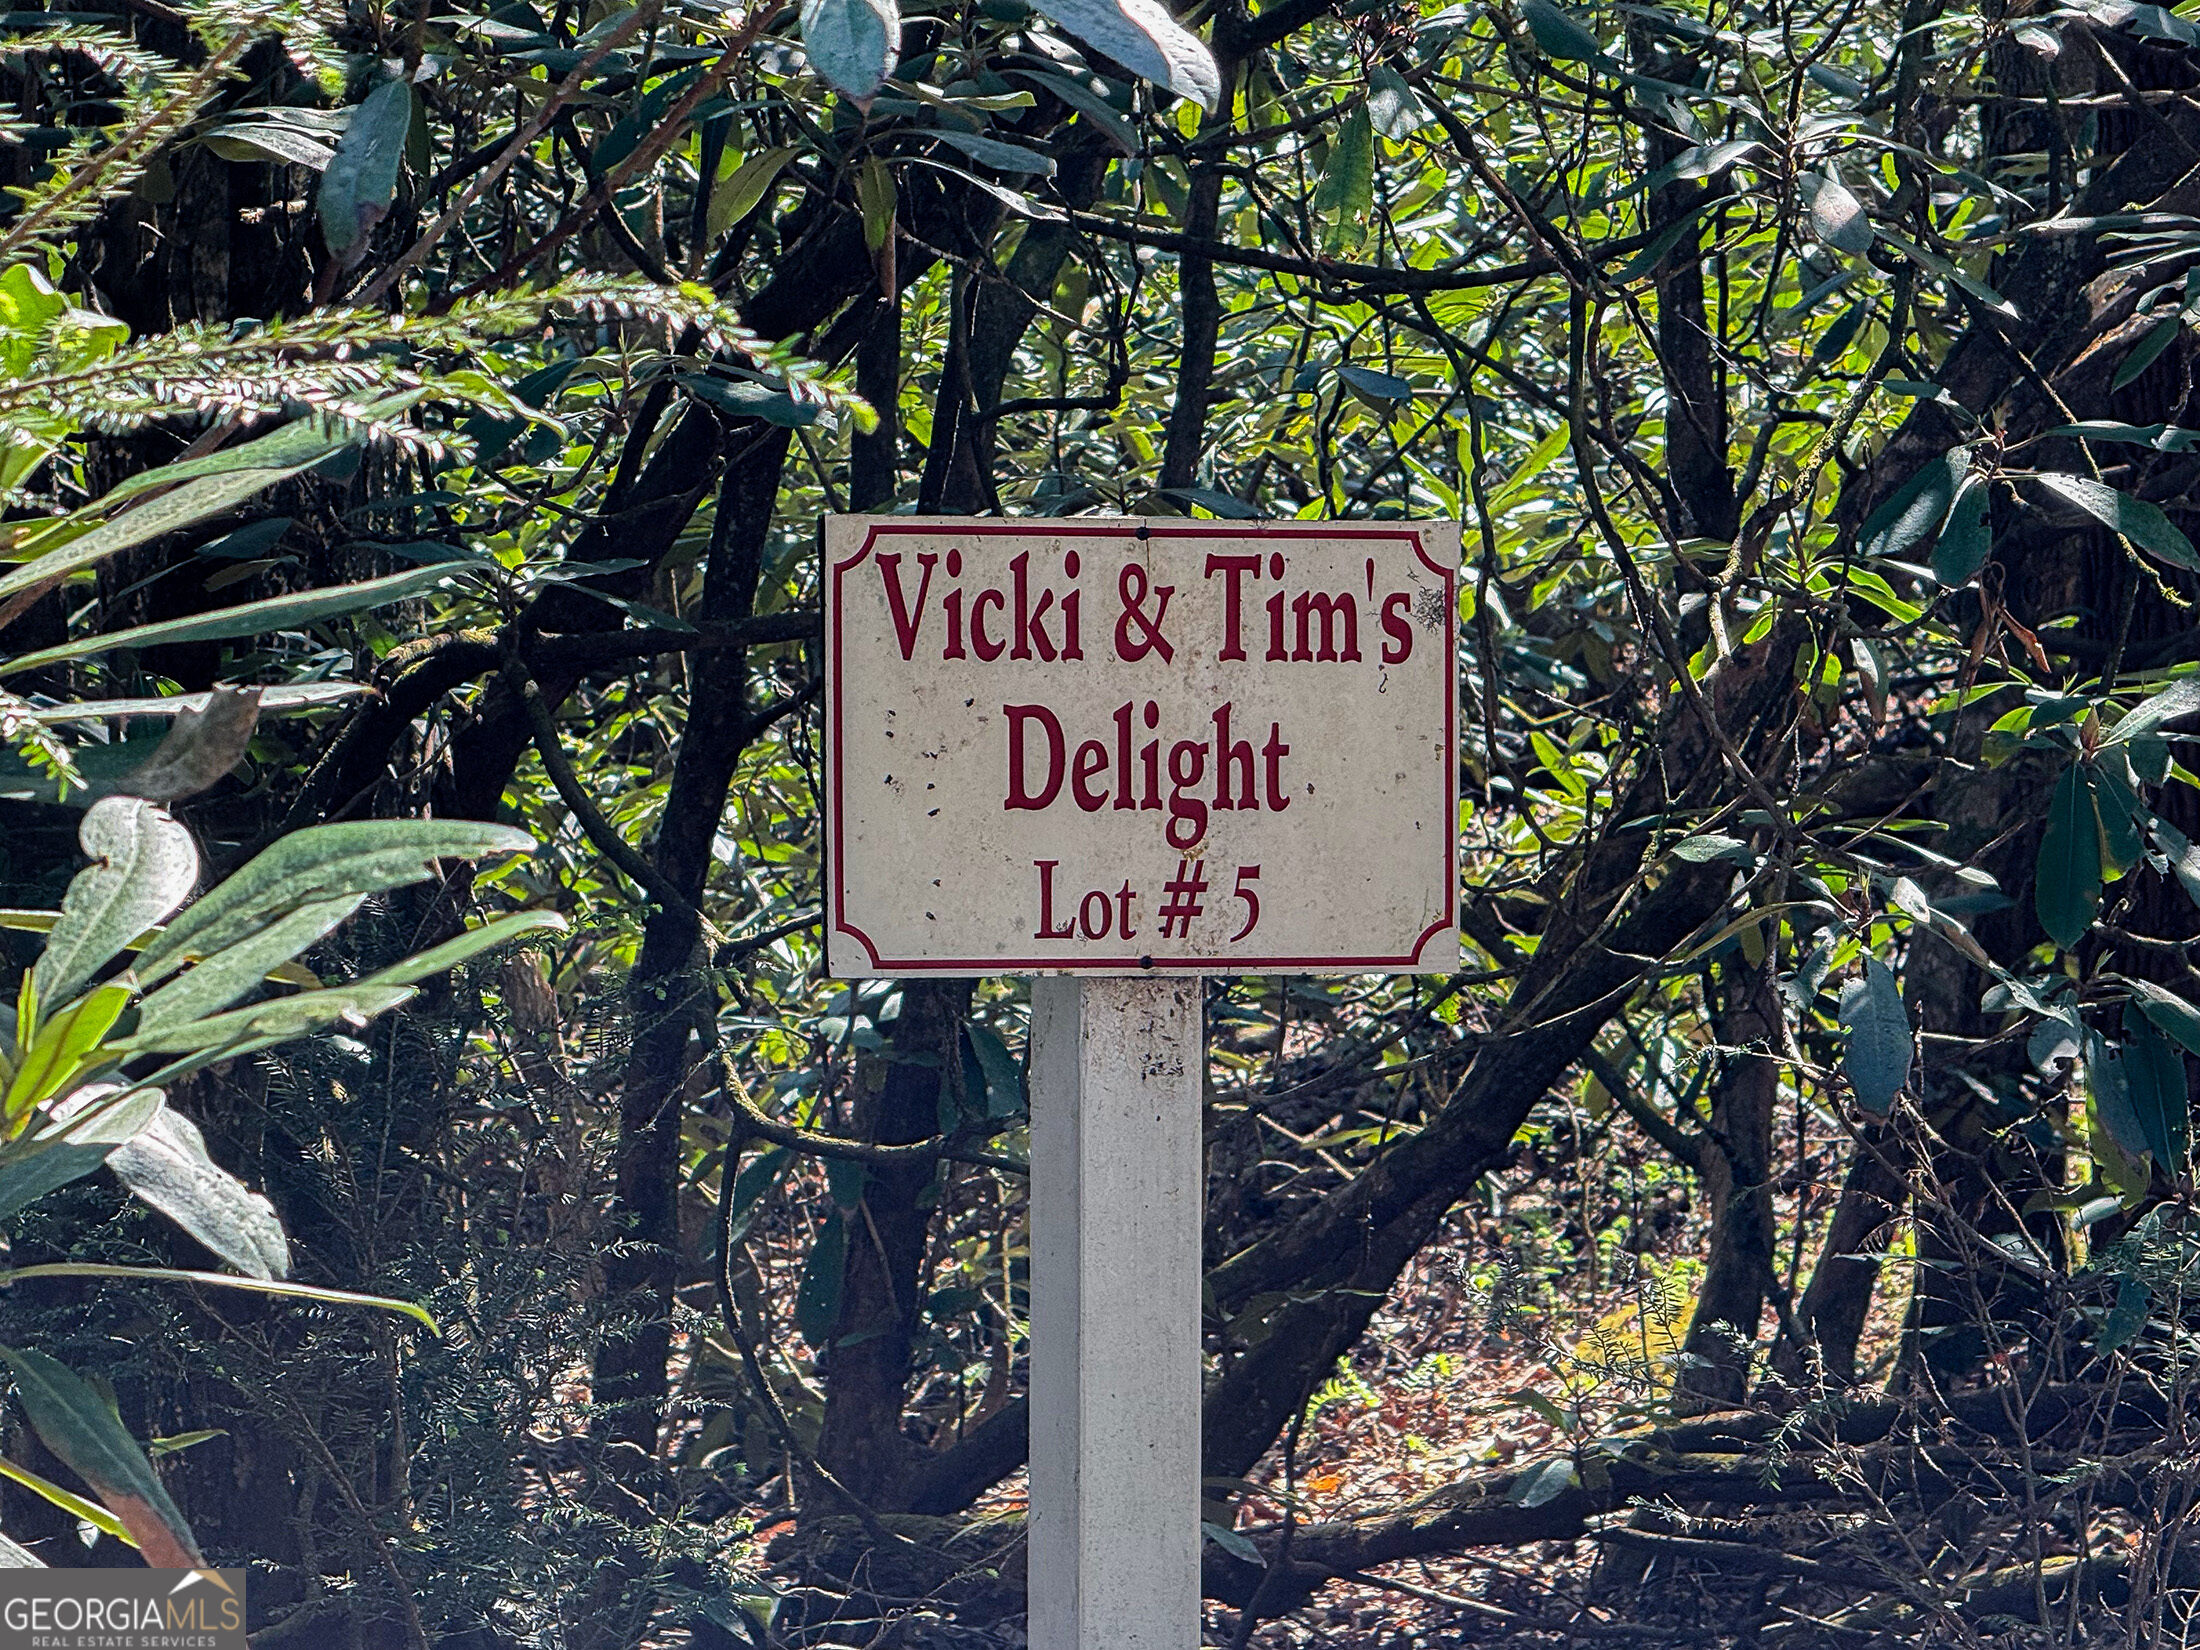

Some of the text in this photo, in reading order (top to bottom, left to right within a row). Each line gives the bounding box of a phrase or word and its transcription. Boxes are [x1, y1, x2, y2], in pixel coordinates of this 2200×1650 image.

[875, 548, 1414, 665] Vicki & Tim's
[1003, 699, 1291, 851] Delight
[1033, 858, 1261, 943] Lot # 5
